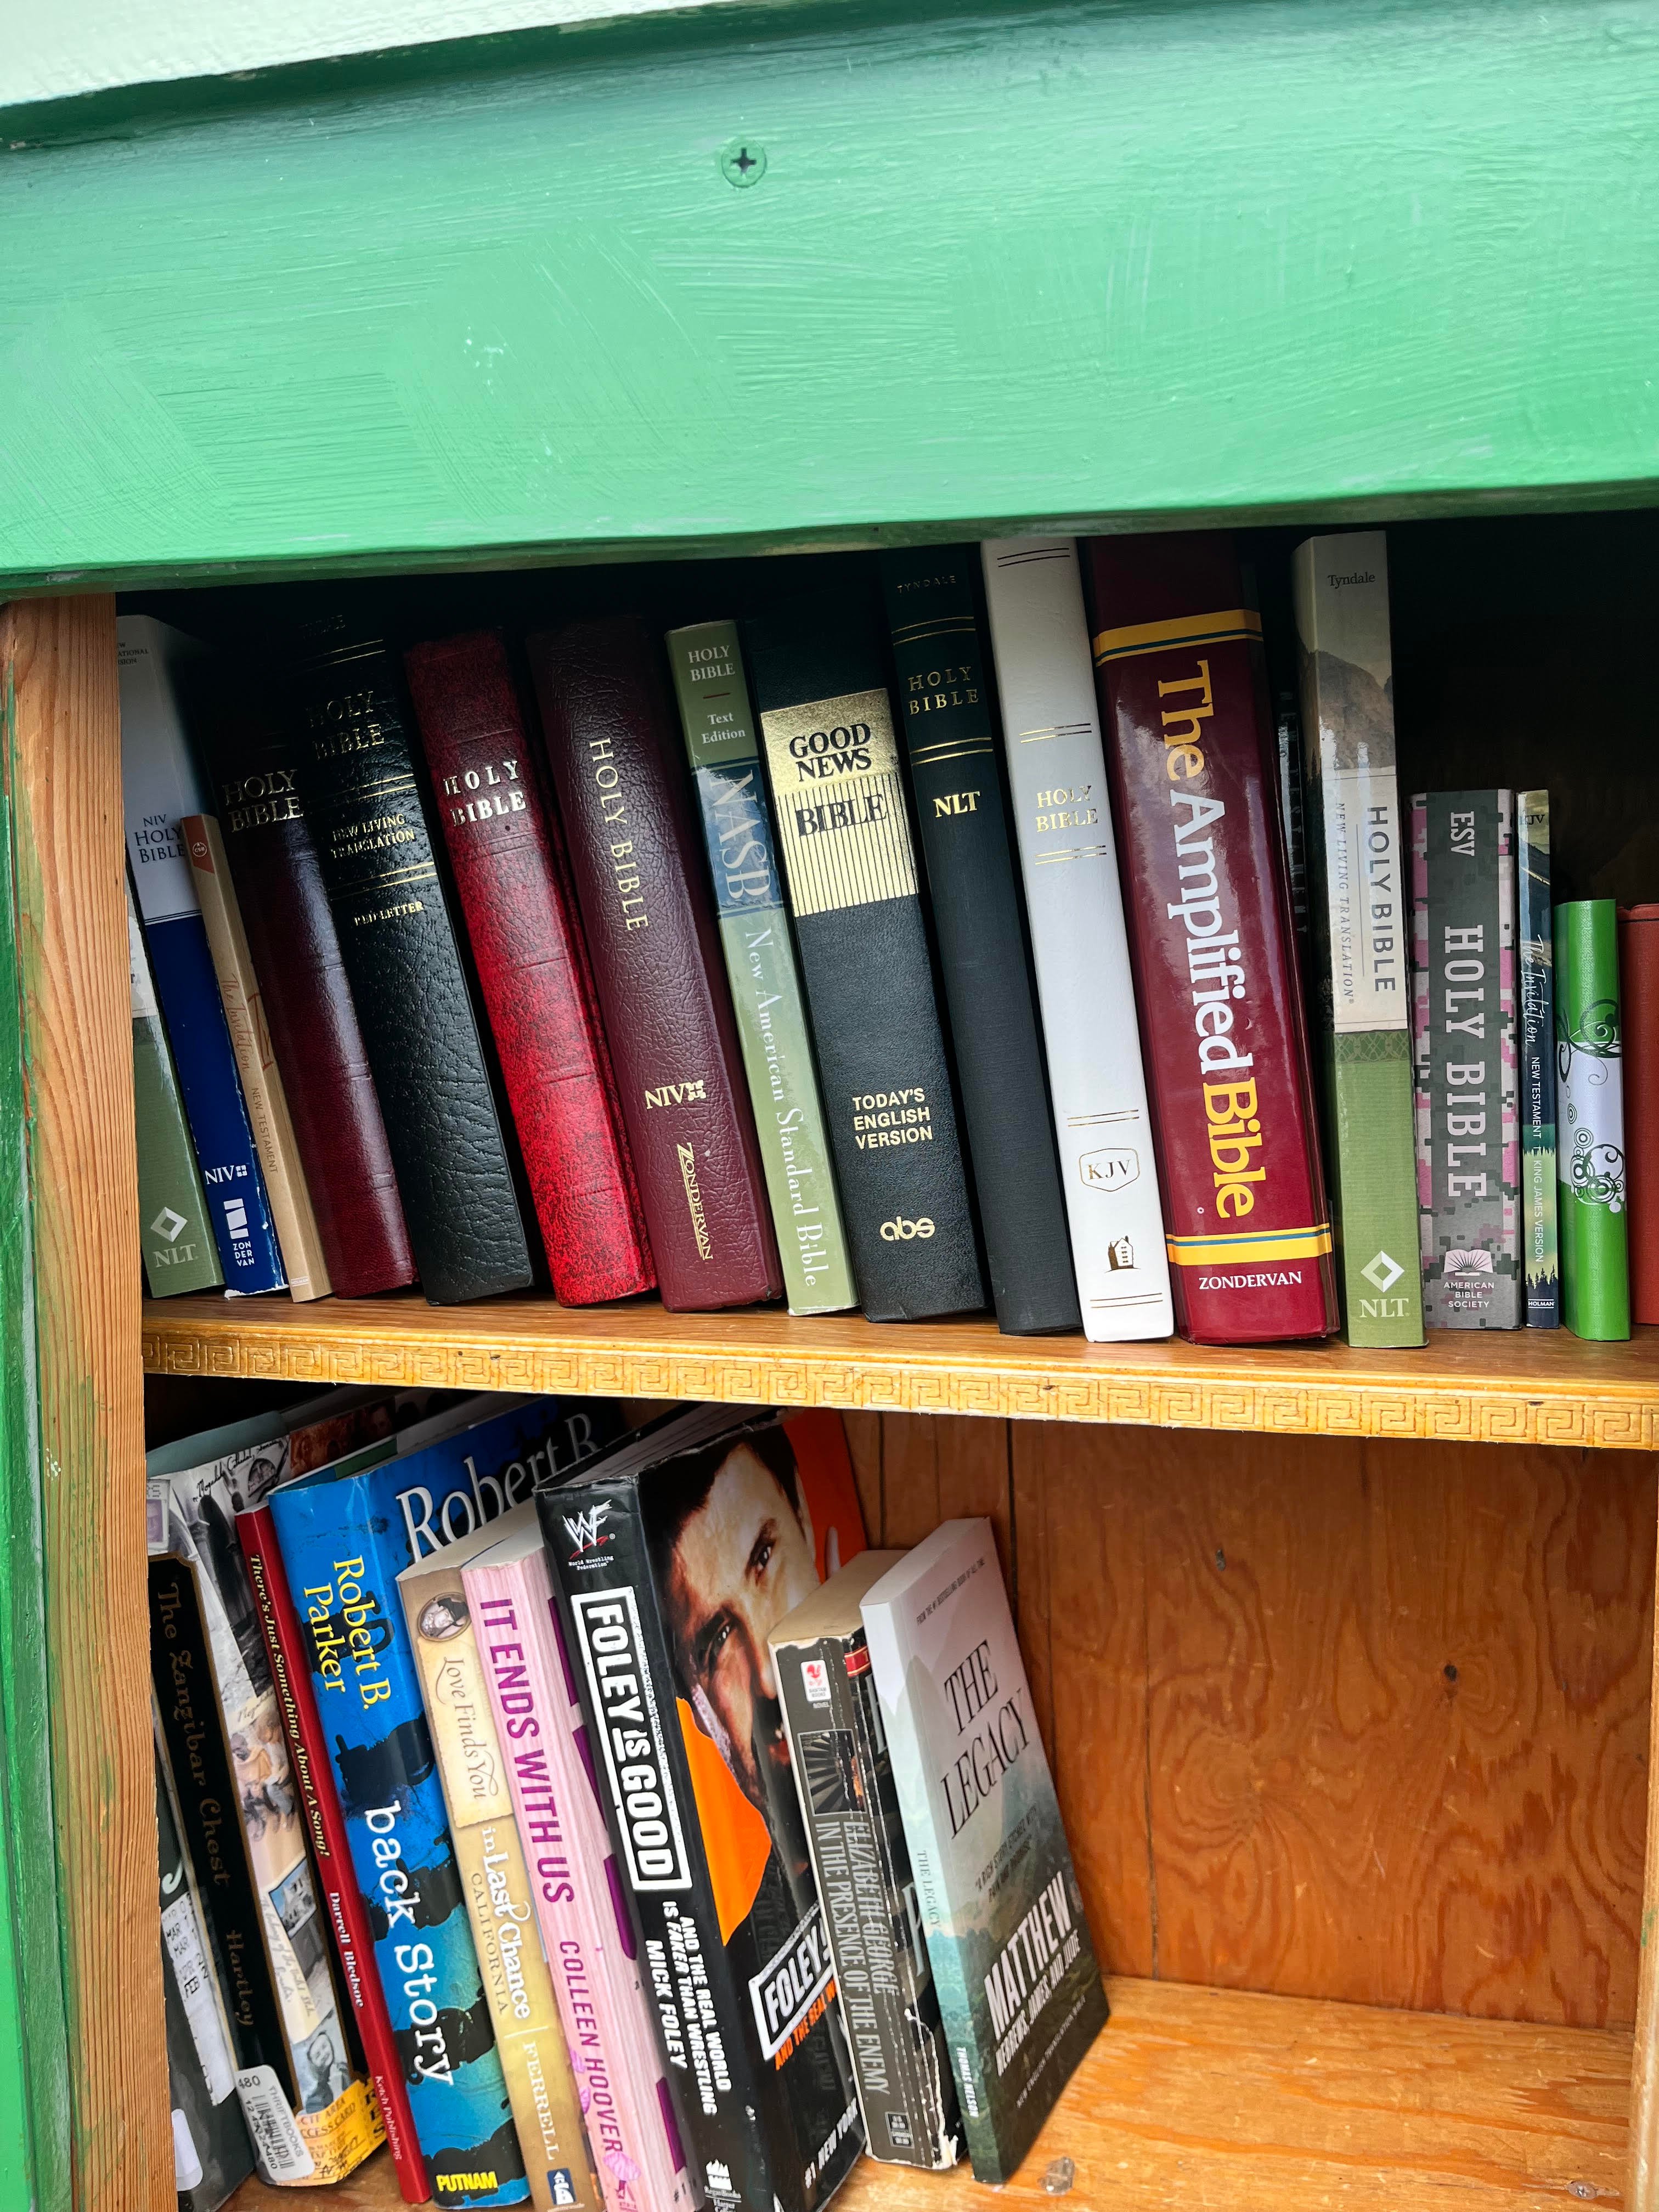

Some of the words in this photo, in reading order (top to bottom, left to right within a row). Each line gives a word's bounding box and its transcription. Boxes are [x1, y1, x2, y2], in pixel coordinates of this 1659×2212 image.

[898, 575, 956, 594] TYNDALE
[1328, 572, 1375, 589] Tyndale
[688, 646, 730, 664] HOLY
[690, 663, 736, 681] BIBLE
[908, 667, 972, 691] HOLY
[707, 713, 733, 725] Text
[910, 689, 979, 715] BIBLE
[1158, 661, 1215, 781] The
[313, 723, 384, 760] BIBLE
[702, 728, 746, 744] Edition
[789, 723, 871, 758] GOOD
[443, 761, 519, 797] HOLY
[797, 748, 871, 781] NEWS
[224, 770, 298, 806] HOLY
[449, 791, 526, 826] BIBLE
[933, 791, 980, 818] NLT
[1037, 785, 1092, 808] HOLY
[135, 826, 182, 847] HOLY
[144, 815, 167, 827] NIV
[229, 797, 303, 832] BIBLE
[362, 814, 405, 835] LIVING
[589, 738, 628, 825] HOLY
[610, 840, 648, 932] BIBLE
[710, 770, 770, 899] NASB
[794, 794, 888, 837] BIBLE
[1036, 809, 1098, 832] BIBLE
[1335, 802, 1347, 837] NEW
[1450, 811, 1475, 856] ESV
[140, 844, 185, 864] BIBLE
[330, 829, 415, 860] TRANSLATION
[1336, 840, 1349, 890] LIVING
[1366, 806, 1390, 893] HOLY
[1167, 788, 1254, 1075] Amplified
[1373, 901, 1396, 993] BIBLE
[1521, 934, 1544, 966] The
[744, 928, 774, 981] New
[221, 974, 240, 1004] The
[1444, 924, 1485, 1039] HOLY
[1521, 968, 1549, 1047] Invitation
[227, 1004, 255, 1070] Invitation
[756, 990, 786, 1102] American
[1532, 1056, 1541, 1079] NEW
[645, 1082, 687, 1109] NIV
[853, 1088, 925, 1111] TODAY'S
[1532, 1081, 1542, 1139] TESTAMENT
[251, 1087, 263, 1109] NEW
[258, 1115, 278, 1173] TESTAMENT
[854, 1107, 930, 1131] ENGLISH
[855, 1125, 933, 1149] VERSION
[1446, 1061, 1487, 1197] BIBLE
[777, 1107, 820, 1217] Standard
[1203, 1076, 1267, 1218] Bible
[205, 1165, 234, 1184] NIV
[1088, 1160, 1131, 1180] KJV
[678, 1142, 713, 1260] ZONDERVAN
[1534, 1186, 1543, 1217] JAMES
[233, 1241, 251, 1250] ZON
[881, 1216, 934, 1241] abs
[1535, 1220, 1544, 1262] VERSION
[154, 1244, 196, 1268] NLT
[235, 1250, 252, 1259] DER
[237, 1257, 255, 1267] VAN
[796, 1223, 829, 1287] Bible
[1199, 1272, 1301, 1290] ZONDERVAN
[1359, 1298, 1409, 1317] NLT
[396, 1440, 561, 1563] Robert
[333, 1555, 381, 1678] Robert
[359, 1678, 391, 1711] B.
[480, 1598, 518, 1630] IT
[304, 1582, 347, 1695] Parker
[436, 1657, 465, 1704] Love
[588, 1604, 645, 1726] FOLEY
[944, 1639, 998, 1736] THE
[249, 1554, 271, 1613] There's
[264, 1615, 280, 1651] Just
[274, 1654, 299, 1740] Something
[294, 1743, 313, 1790] About
[310, 1804, 331, 1857] Song!
[489, 1643, 539, 1739] ENDS
[157, 1583, 181, 1639] The
[170, 1650, 206, 1788] Zanzibar
[200, 1798, 229, 1885] Chest
[455, 1703, 479, 1758] Finds
[623, 1729, 650, 1758] IS
[466, 1750, 498, 1800] You
[940, 1689, 1030, 1839] LEGACY
[514, 1748, 562, 1844] WITH
[482, 1826, 496, 1855] in
[620, 1763, 674, 1877] GOOD
[815, 1821, 832, 1844] IN
[364, 1801, 417, 1932] back
[537, 1857, 575, 1904] US
[818, 1848, 840, 1880] THE
[844, 1822, 882, 1921] ELIZABETH
[917, 1850, 932, 1877] THE
[483, 1852, 529, 1923] Last
[662, 1901, 678, 1917] IS
[923, 1880, 941, 1927] LEGACY
[470, 1874, 508, 2016] CALIFORNIA
[665, 1921, 689, 1974] FAKER
[680, 1916, 699, 1951] AND
[827, 1882, 864, 1968] PRESENCE
[329, 1893, 351, 1944] Darrell
[343, 1950, 363, 2008] Bledsoe
[498, 1923, 532, 2019] Chance
[689, 1953, 707, 1985] THE
[862, 1922, 899, 1995] GEORGE
[985, 1871, 1071, 2041] MATTHEW
[1049, 1953, 1064, 1989] AND
[1063, 1929, 1080, 1970] JUDE
[225, 1929, 253, 2027] Hartley
[678, 1976, 697, 2022] THAN
[765, 1928, 822, 2032] FOLEY
[843, 1971, 870, 1995] OF
[646, 1939, 672, 2000] MICK
[660, 2002, 687, 2069] FOLEY
[696, 1989, 715, 2028] REAL
[850, 1993, 874, 2024] THE
[560, 1941, 592, 2046] COLLEEN
[585, 2057, 624, 2154] HOOVER
[775, 2037, 793, 2070] AND
[792, 2022, 810, 2046] THE
[808, 1996, 827, 2028] REAL
[685, 2024, 718, 2115] WRESTLING
[706, 2032, 732, 2091] WORLD
[857, 2027, 890, 2094] ENEMY
[268, 2085, 304, 2157] THRIFTBOOKS
[522, 2041, 560, 2160] FERRELL
[819, 2130, 836, 2169] NEW
[436, 2171, 498, 2192] PUTNAM
